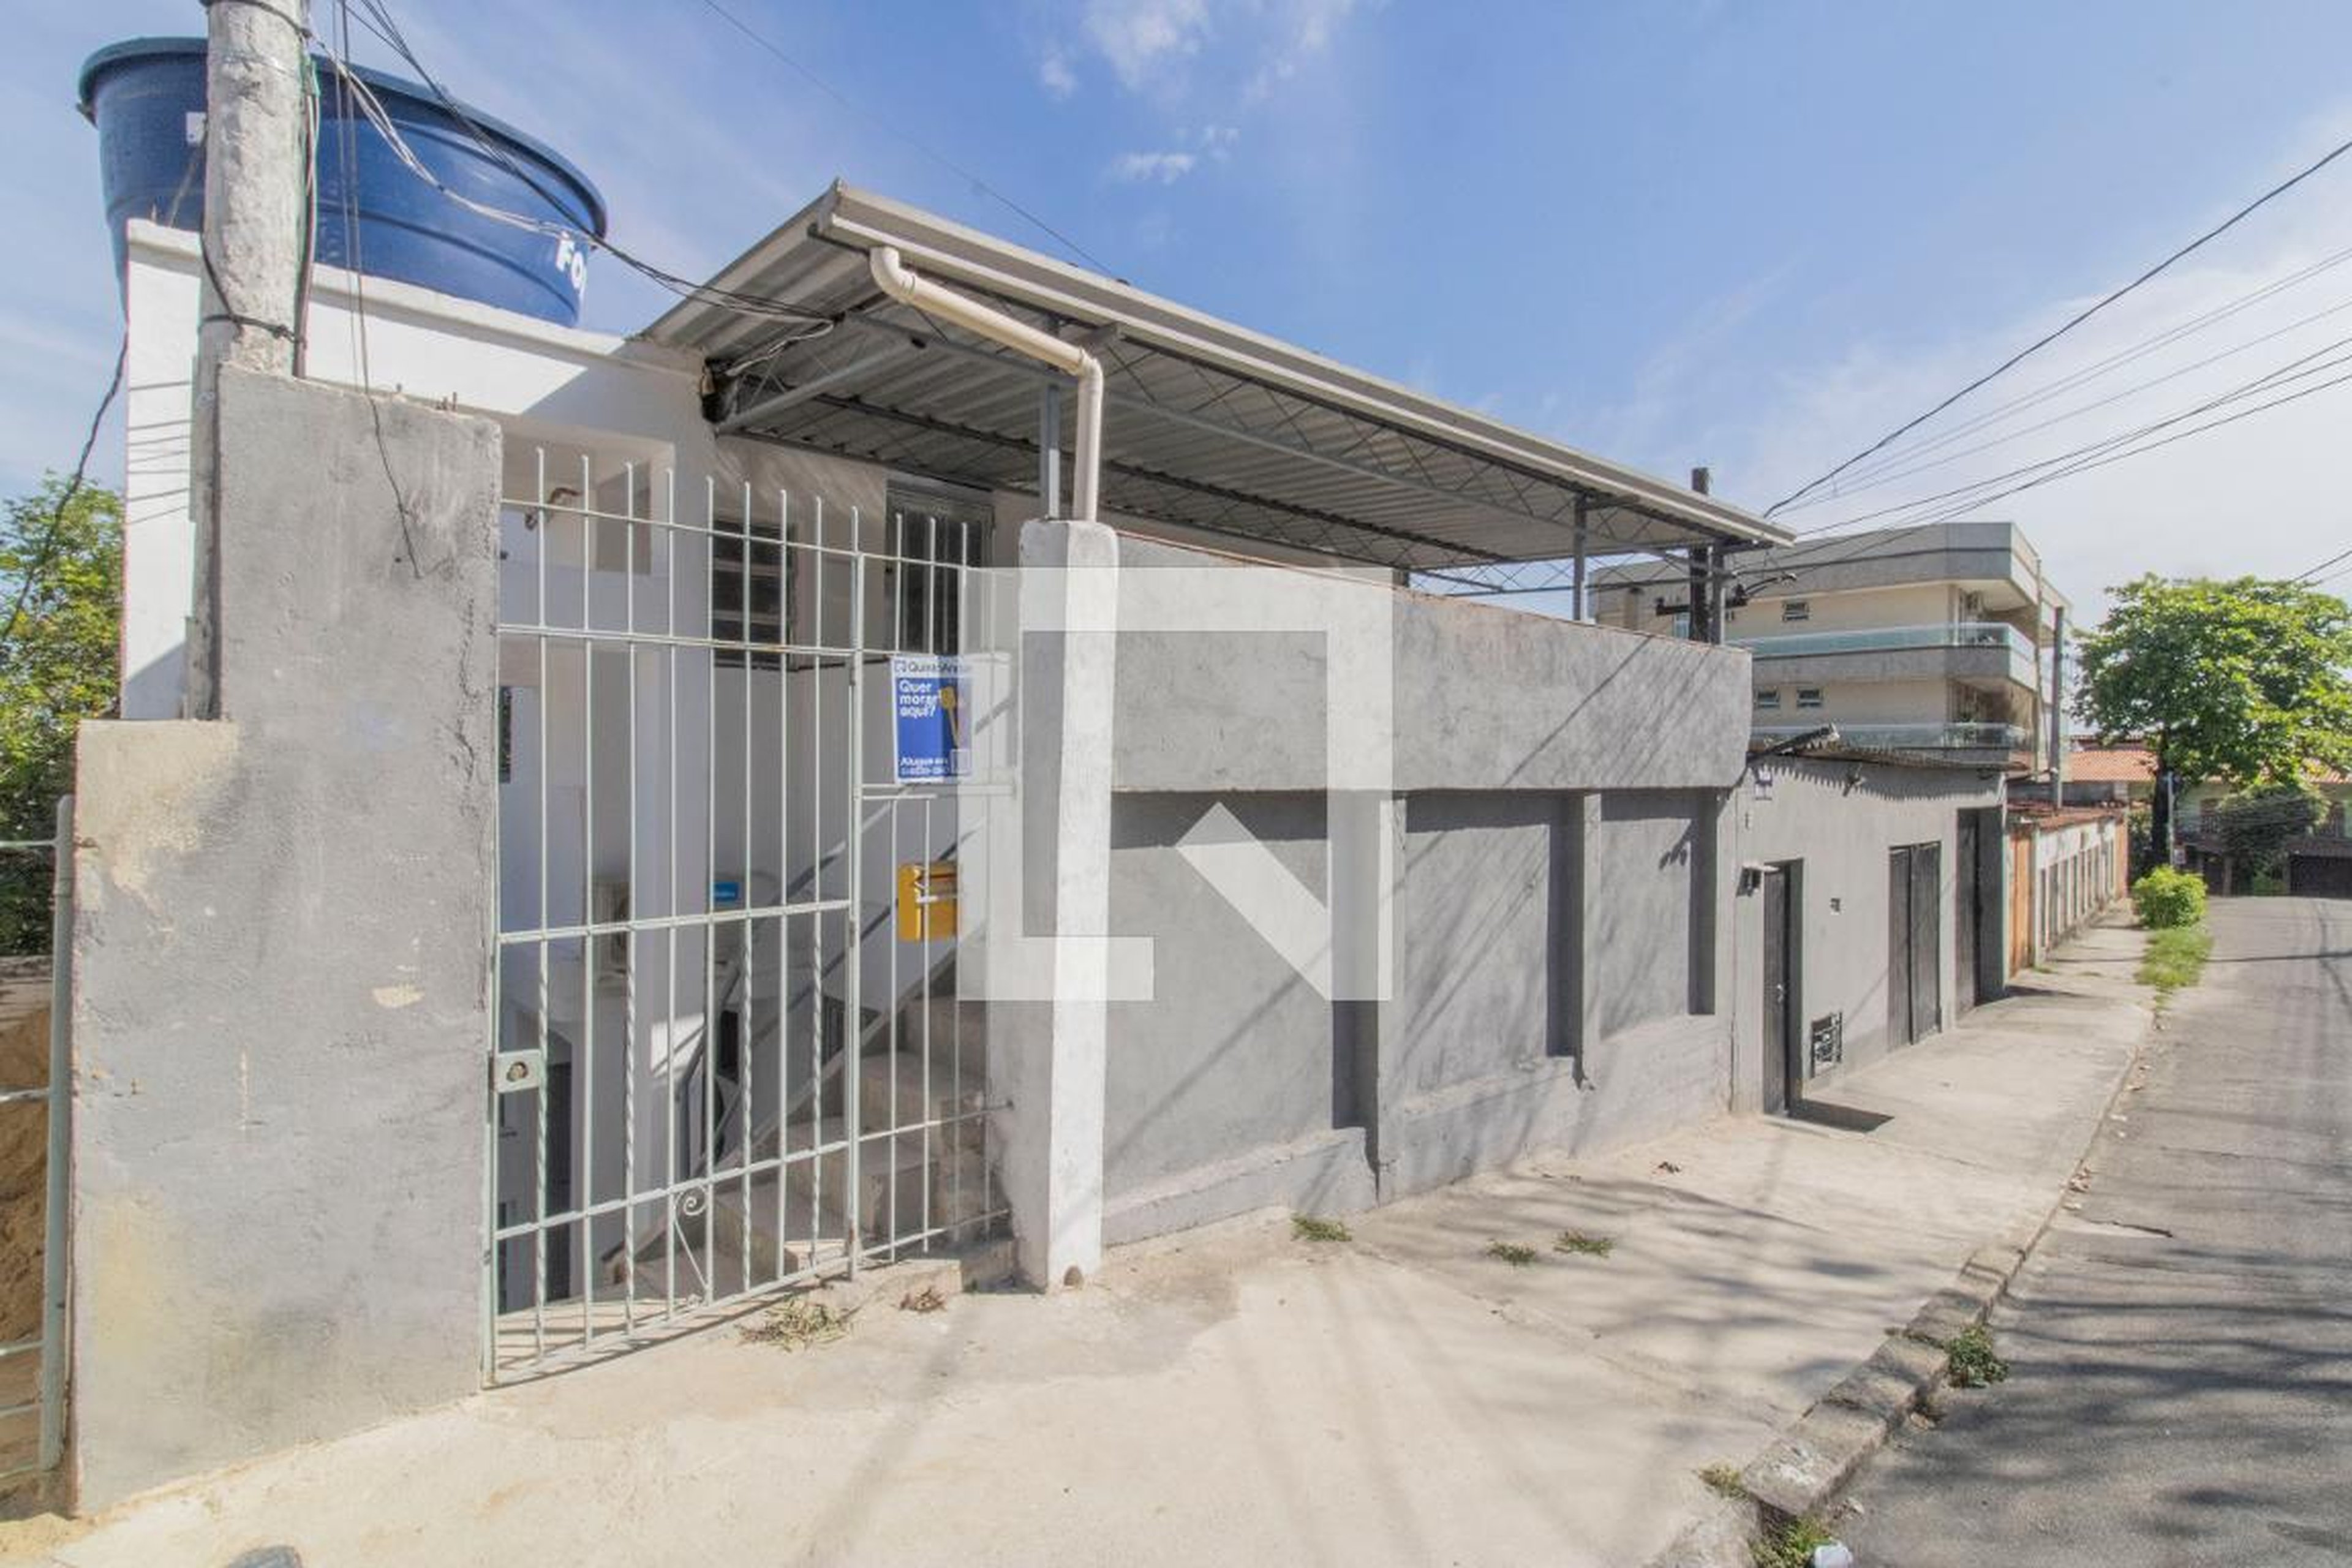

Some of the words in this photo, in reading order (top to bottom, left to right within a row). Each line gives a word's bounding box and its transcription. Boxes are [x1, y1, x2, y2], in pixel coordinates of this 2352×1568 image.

[899, 679, 932, 693] Quer
[899, 694, 938, 705] morar
[899, 706, 936, 718] aqui?
